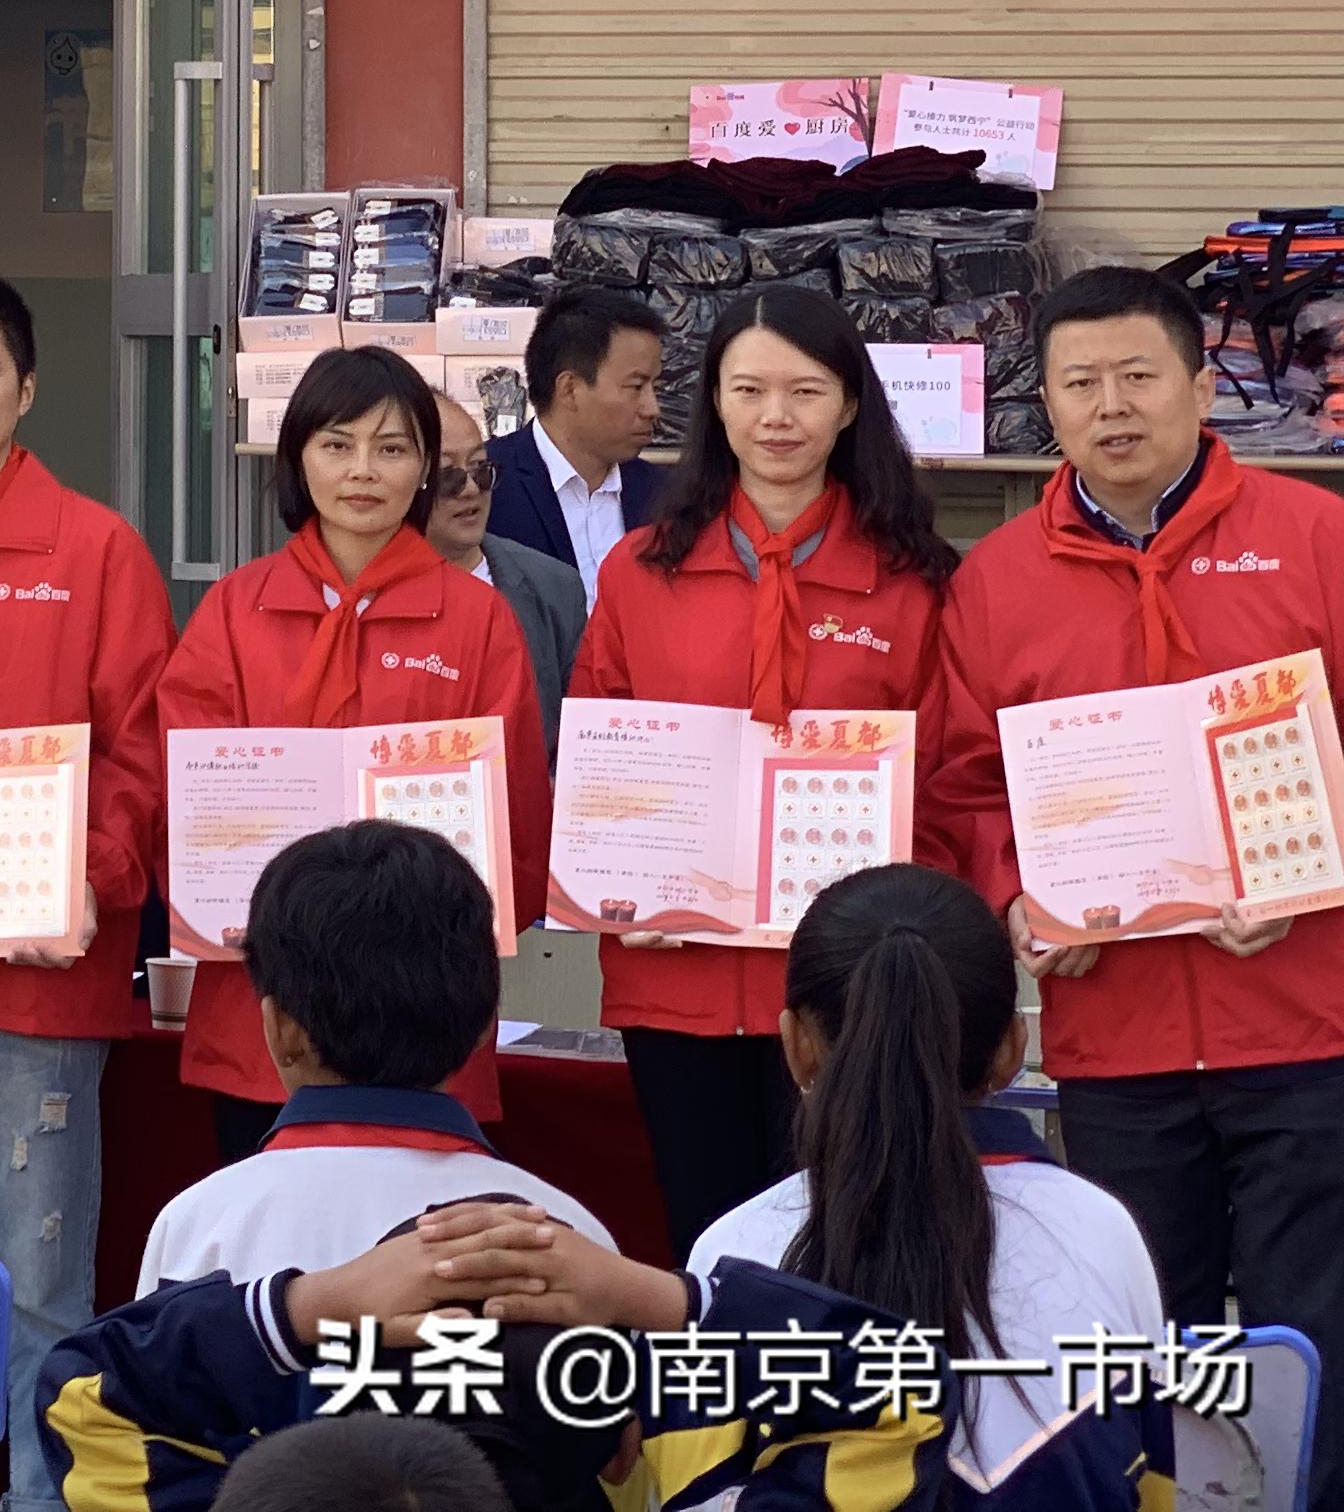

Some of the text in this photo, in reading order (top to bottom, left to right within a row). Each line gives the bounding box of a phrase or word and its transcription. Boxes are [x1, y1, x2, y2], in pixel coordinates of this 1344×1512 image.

[608, 717, 681, 732] 爱心证书
[1049, 710, 1124, 732] 爱心证书
[215, 746, 284, 757] 爱心证书
